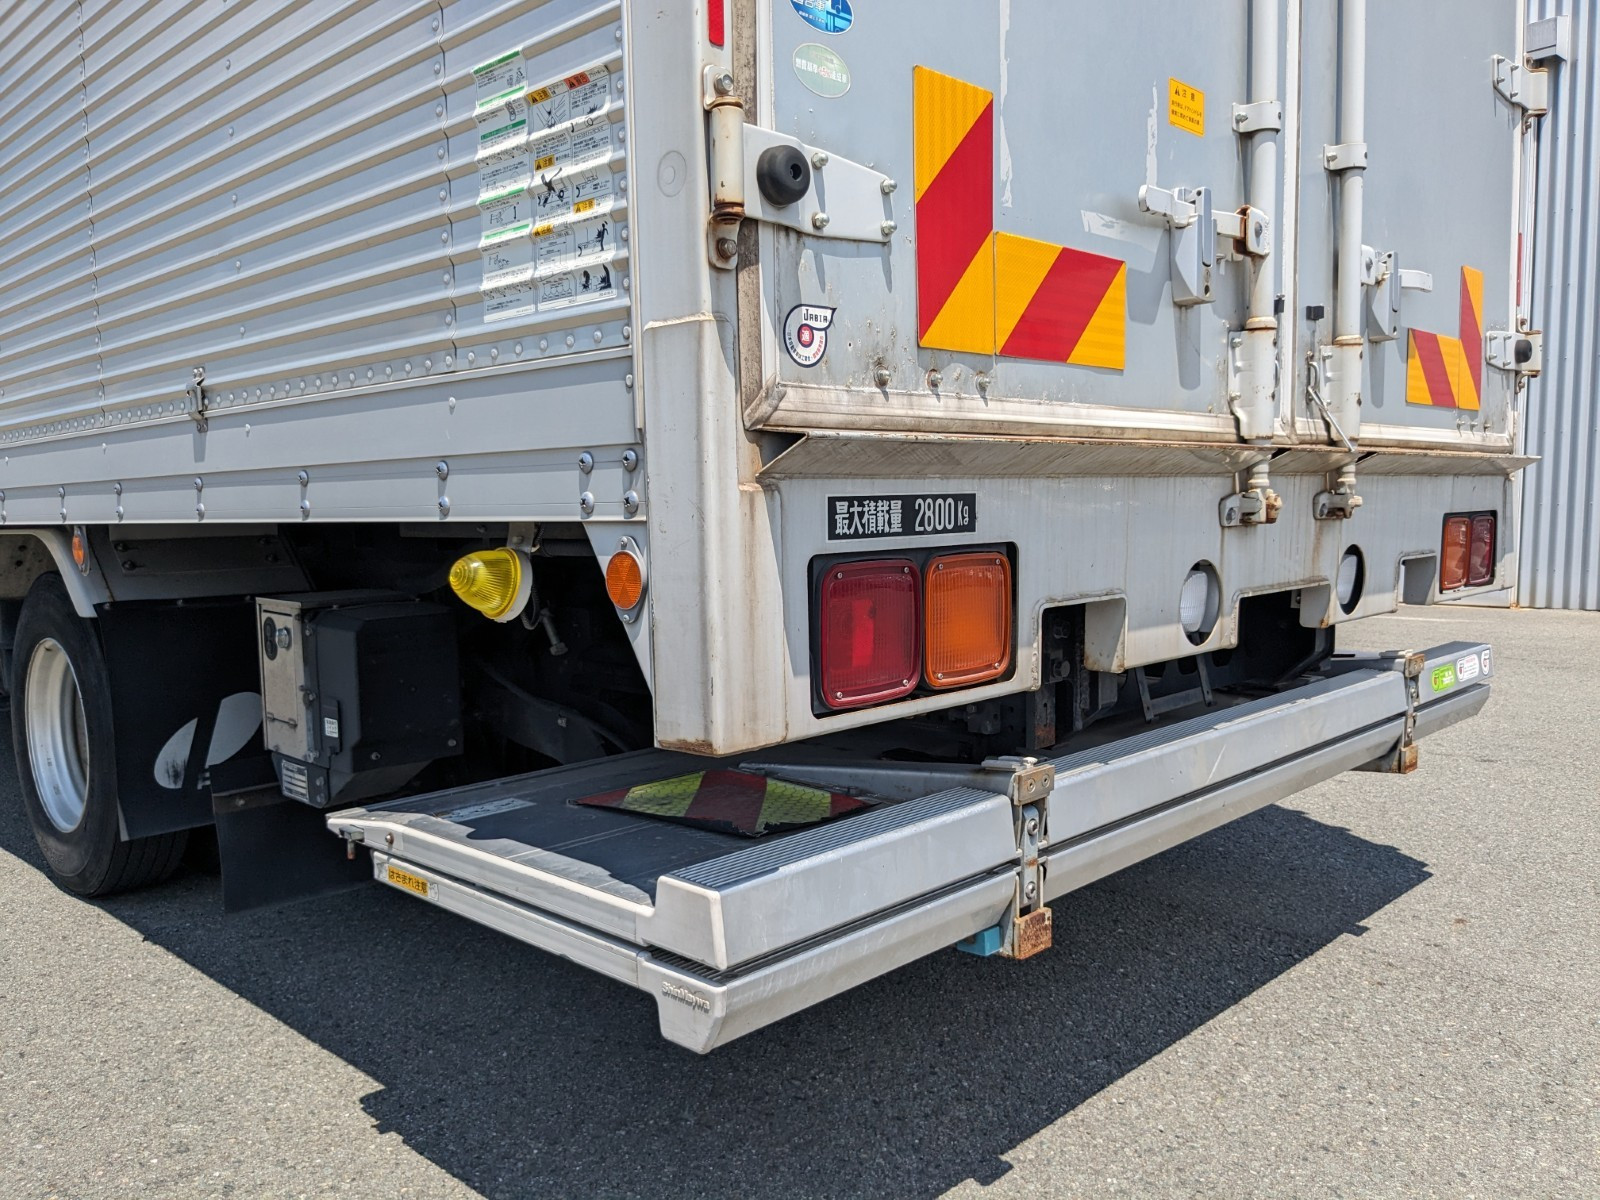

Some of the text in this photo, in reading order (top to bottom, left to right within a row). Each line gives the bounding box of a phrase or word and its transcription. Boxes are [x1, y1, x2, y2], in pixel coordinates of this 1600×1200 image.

[803, 308, 828, 323] JABIA
[835, 497, 969, 536] 最大積載量 2800 Kg
[389, 870, 428, 894] はさまれ注意
